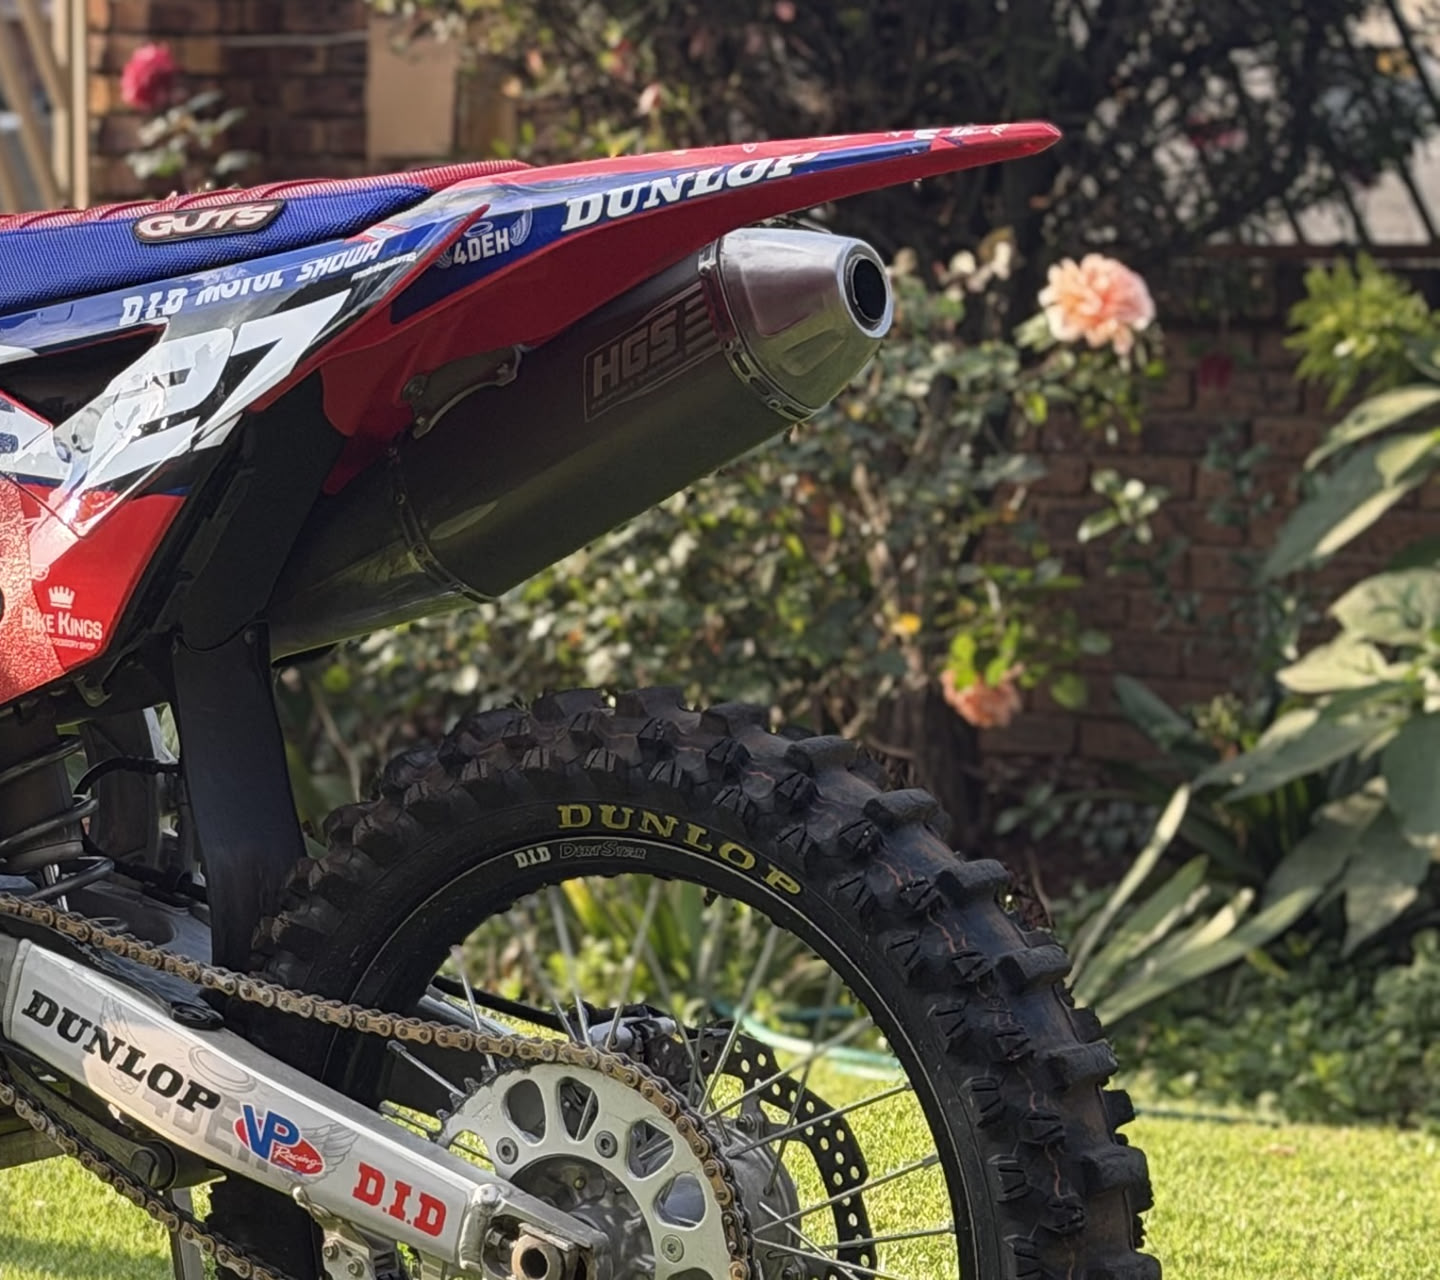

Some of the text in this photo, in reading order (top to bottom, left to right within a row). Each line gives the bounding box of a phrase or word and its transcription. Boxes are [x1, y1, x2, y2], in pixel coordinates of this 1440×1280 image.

[137, 205, 277, 237] GUTS
[562, 150, 821, 231] DUNLOP
[194, 269, 284, 307] MOTUL
[296, 238, 386, 282] SHOWA
[453, 229, 509, 265] 4DEH
[593, 308, 678, 398] HGS
[58, 610, 103, 641] KINGS
[557, 804, 802, 895] DUNLOP
[21, 989, 222, 1113] DUNLOP
[239, 1102, 302, 1162] VP
[273, 1144, 322, 1170] Racing
